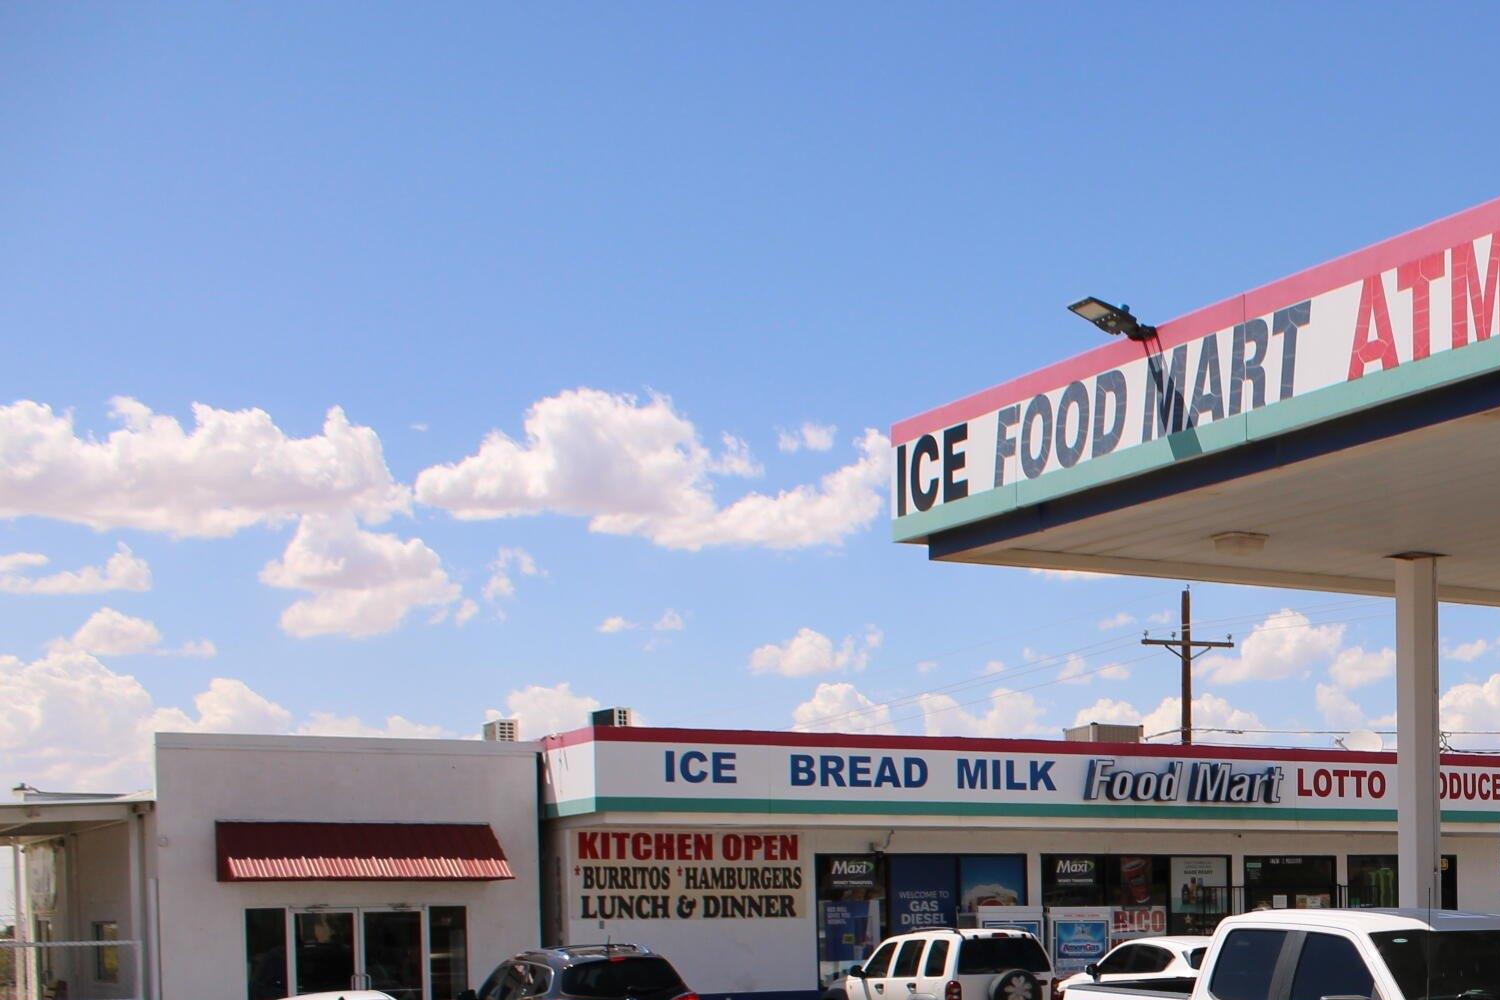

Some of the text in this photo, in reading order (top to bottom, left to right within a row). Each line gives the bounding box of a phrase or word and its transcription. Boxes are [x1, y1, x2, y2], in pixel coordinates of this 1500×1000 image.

[897, 421, 968, 517] ICE
[994, 369, 1128, 488] FOOD
[1141, 299, 1312, 444] MART
[664, 750, 738, 784] ICE
[790, 754, 929, 788] BREAD
[956, 758, 1057, 792] MILK
[1083, 759, 1182, 802] Food
[1187, 761, 1284, 804] Mart
[1297, 768, 1386, 800] LOTTO
[578, 831, 799, 861] KITCHEN OPEN
[831, 860, 867, 875] Maxi
[1056, 860, 1089, 873] Maxi
[899, 890, 950, 899] WELCOME TO
[581, 895, 797, 919] LUNCH & DINNER
[909, 900, 939, 912] GAS
[901, 913, 947, 925] DIESEL
